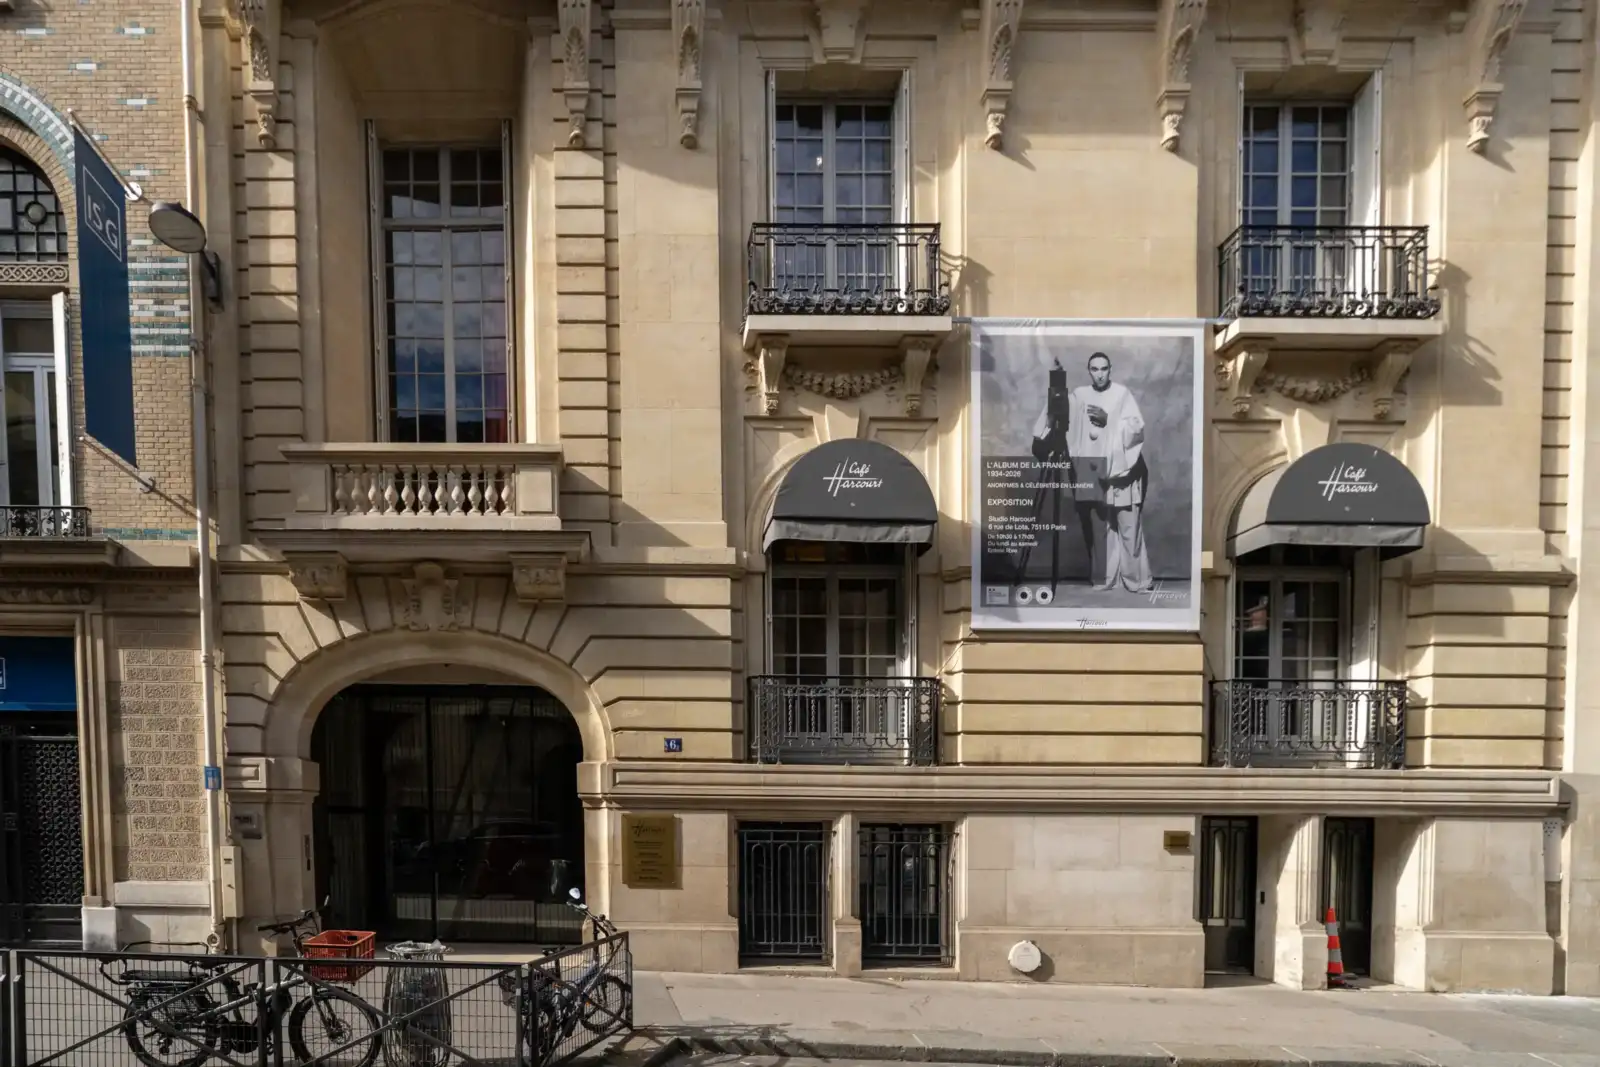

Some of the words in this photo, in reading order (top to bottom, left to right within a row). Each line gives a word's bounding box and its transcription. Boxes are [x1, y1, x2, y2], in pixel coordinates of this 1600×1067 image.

[88, 194, 118, 249] ISG
[823, 456, 883, 497] Harcourt
[849, 461, 871, 477] Café
[1318, 460, 1378, 501] Harcourt
[987, 498, 1034, 506] EXPOSITION
[669, 739, 677, 750] 6
